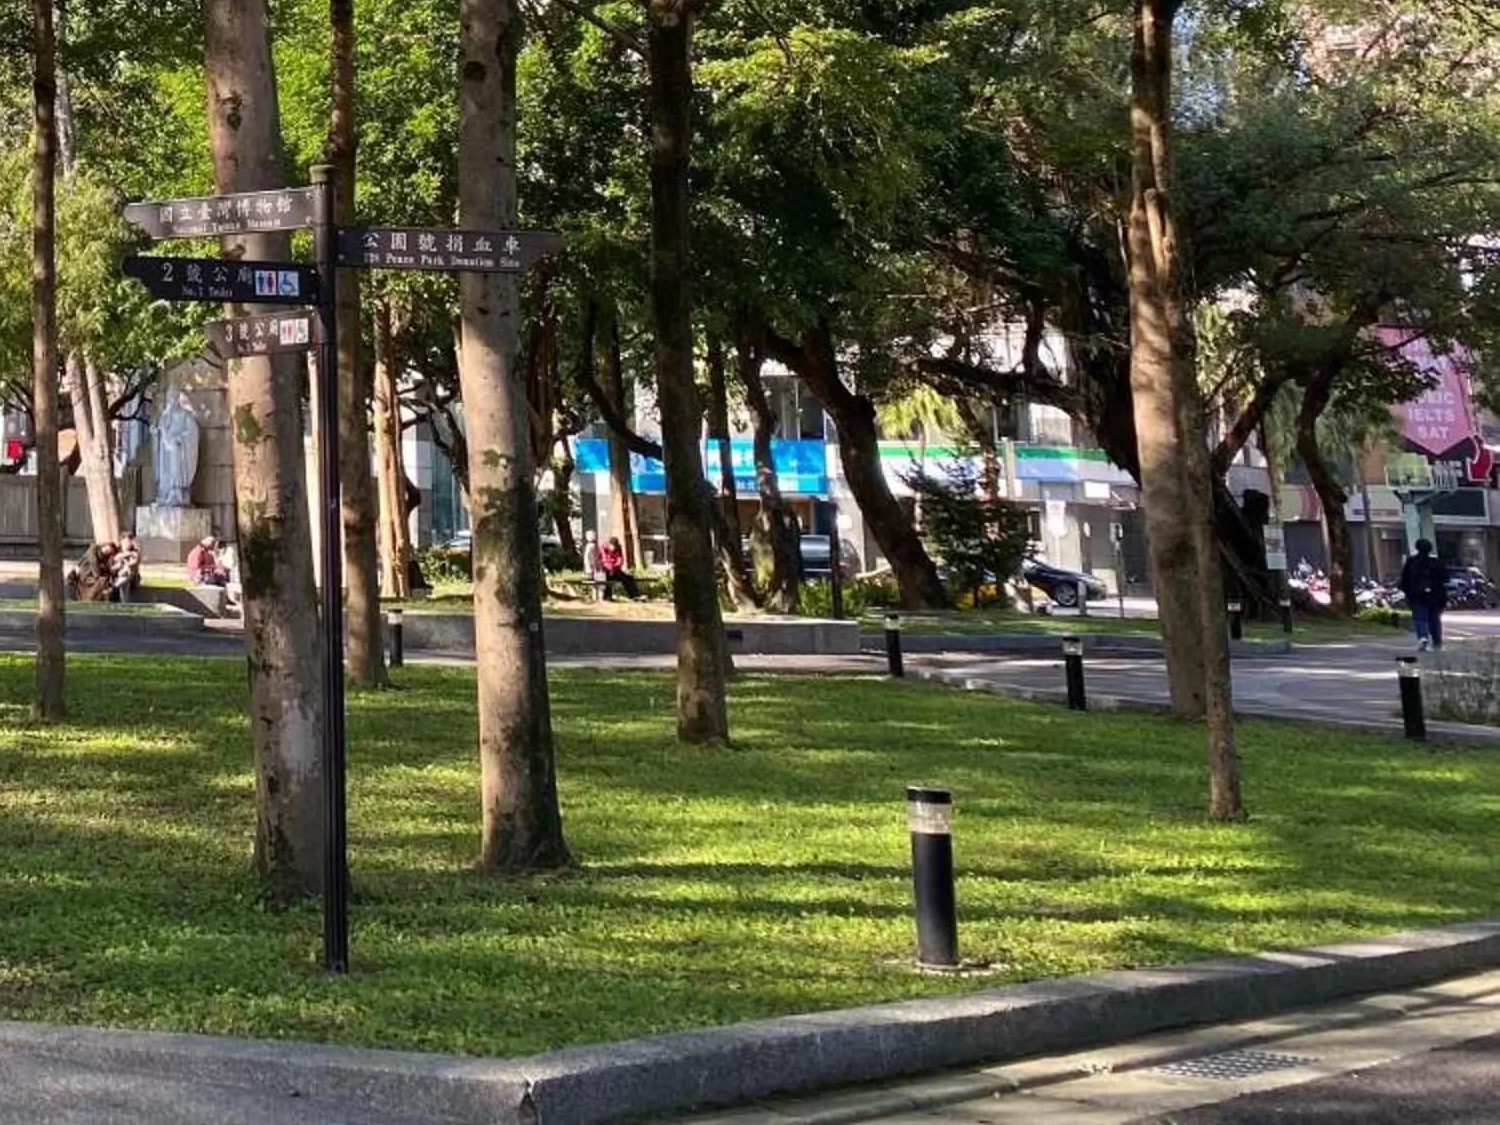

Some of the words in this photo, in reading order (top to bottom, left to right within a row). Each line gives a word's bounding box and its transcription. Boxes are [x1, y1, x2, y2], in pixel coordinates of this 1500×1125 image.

[363, 231, 521, 256] 公園號捐血車
[385, 252, 415, 265] Peace
[420, 253, 445, 266] Park
[1407, 407, 1456, 422] IELTS
[1416, 426, 1450, 440] SAT
